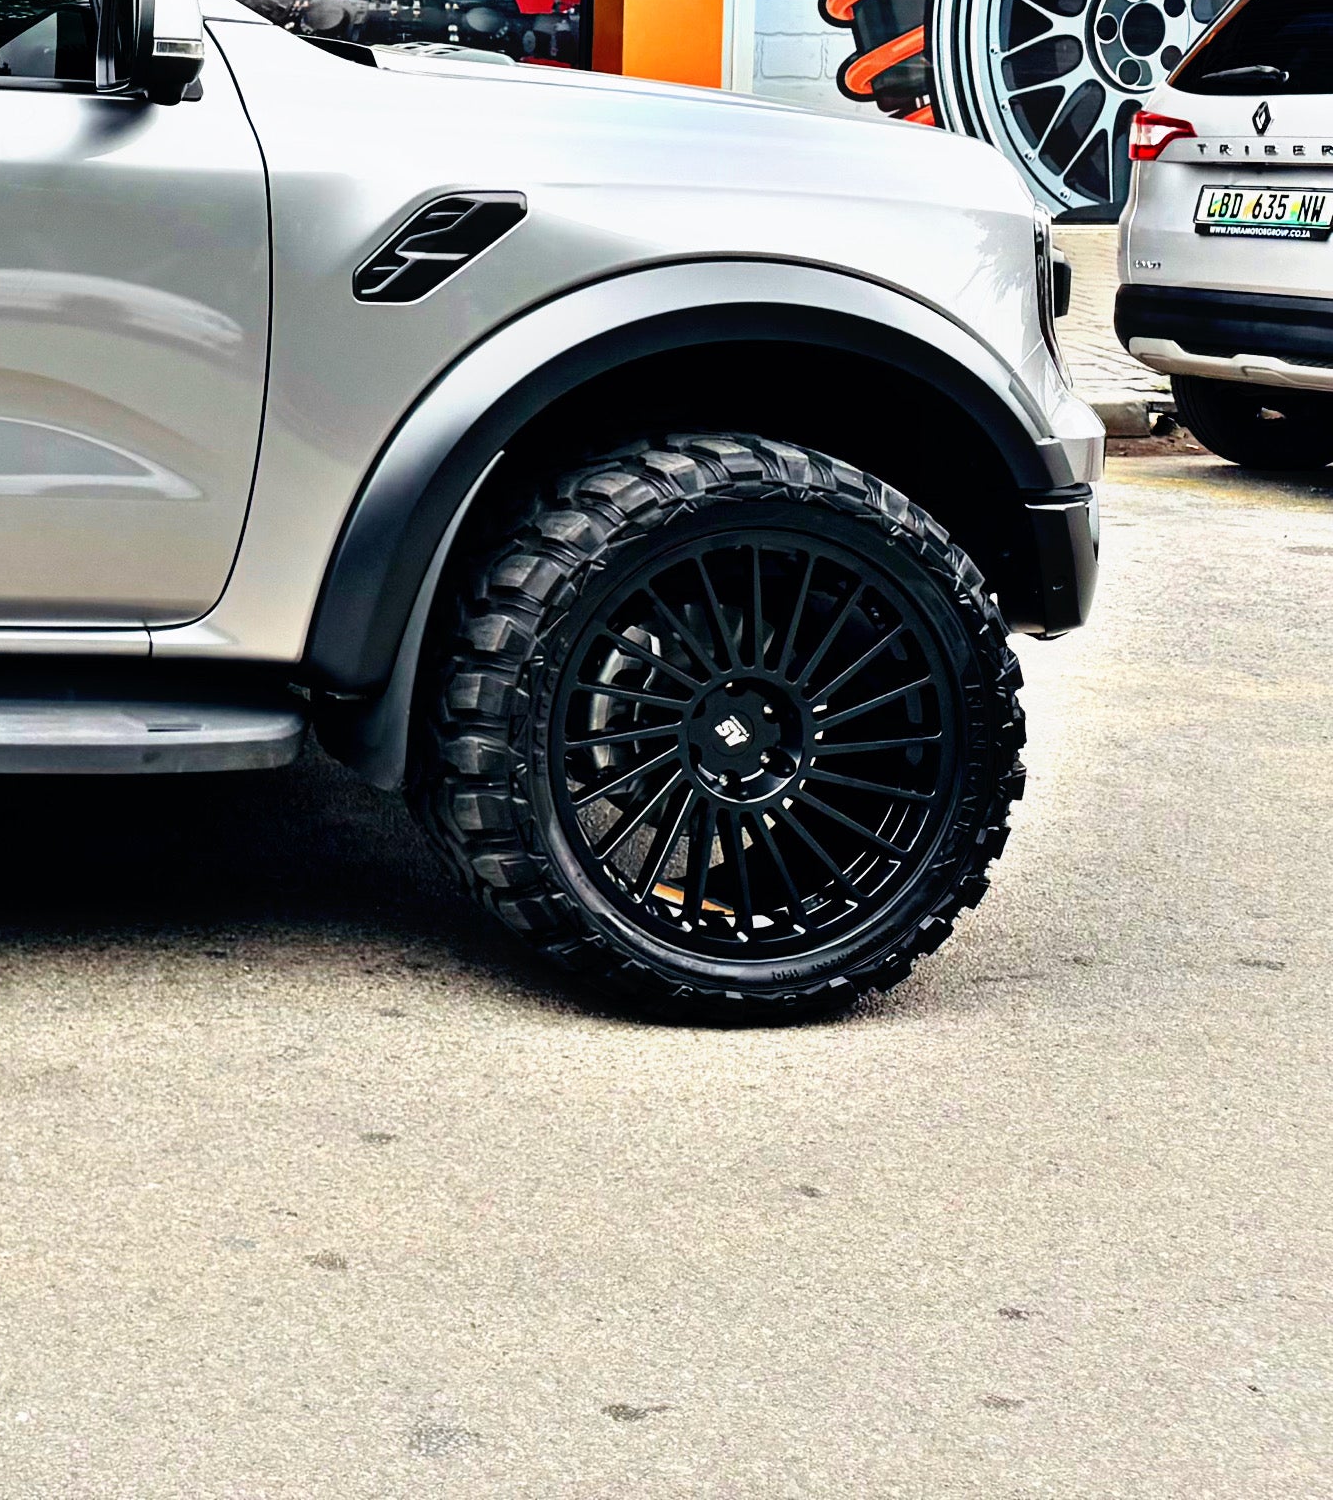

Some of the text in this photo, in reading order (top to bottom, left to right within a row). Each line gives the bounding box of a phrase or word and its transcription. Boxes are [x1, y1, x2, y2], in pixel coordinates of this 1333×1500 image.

[1206, 192, 1326, 223] LBD 635 NW
